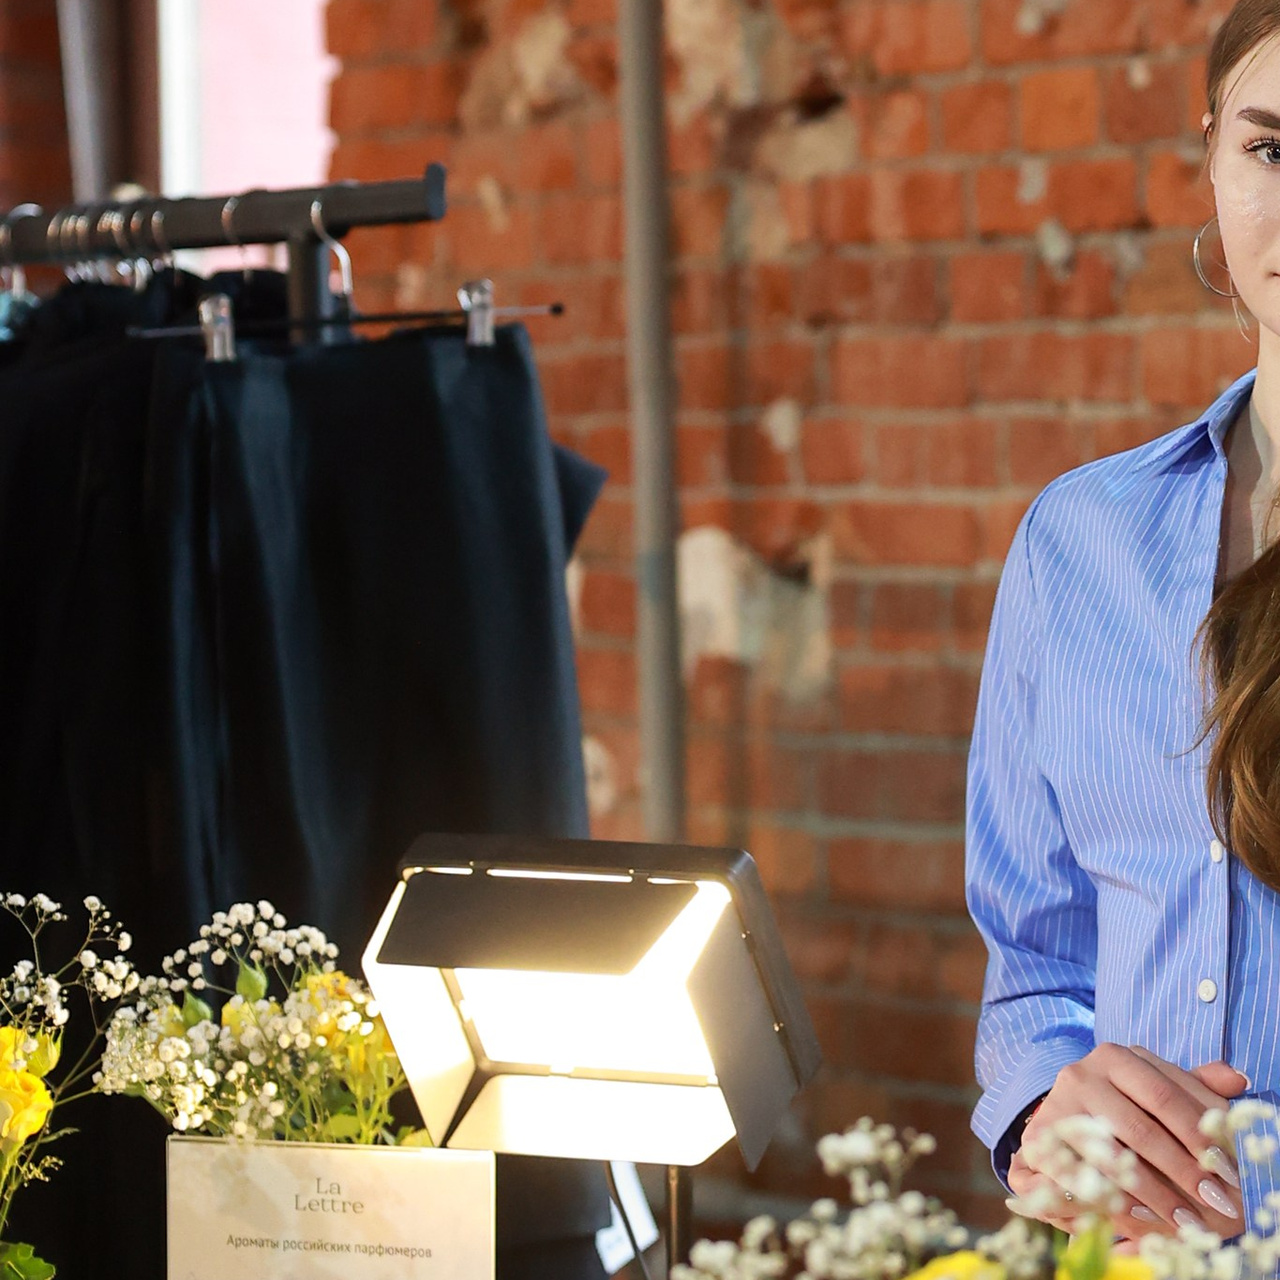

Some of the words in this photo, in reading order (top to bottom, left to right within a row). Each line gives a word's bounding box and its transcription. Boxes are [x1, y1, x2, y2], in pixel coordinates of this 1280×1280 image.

[316, 1177, 341, 1195] La
[294, 1194, 365, 1215] Lettre
[226, 1234, 279, 1250] Ароматы
[282, 1238, 350, 1253] российских
[354, 1243, 433, 1259] парфюмеров
